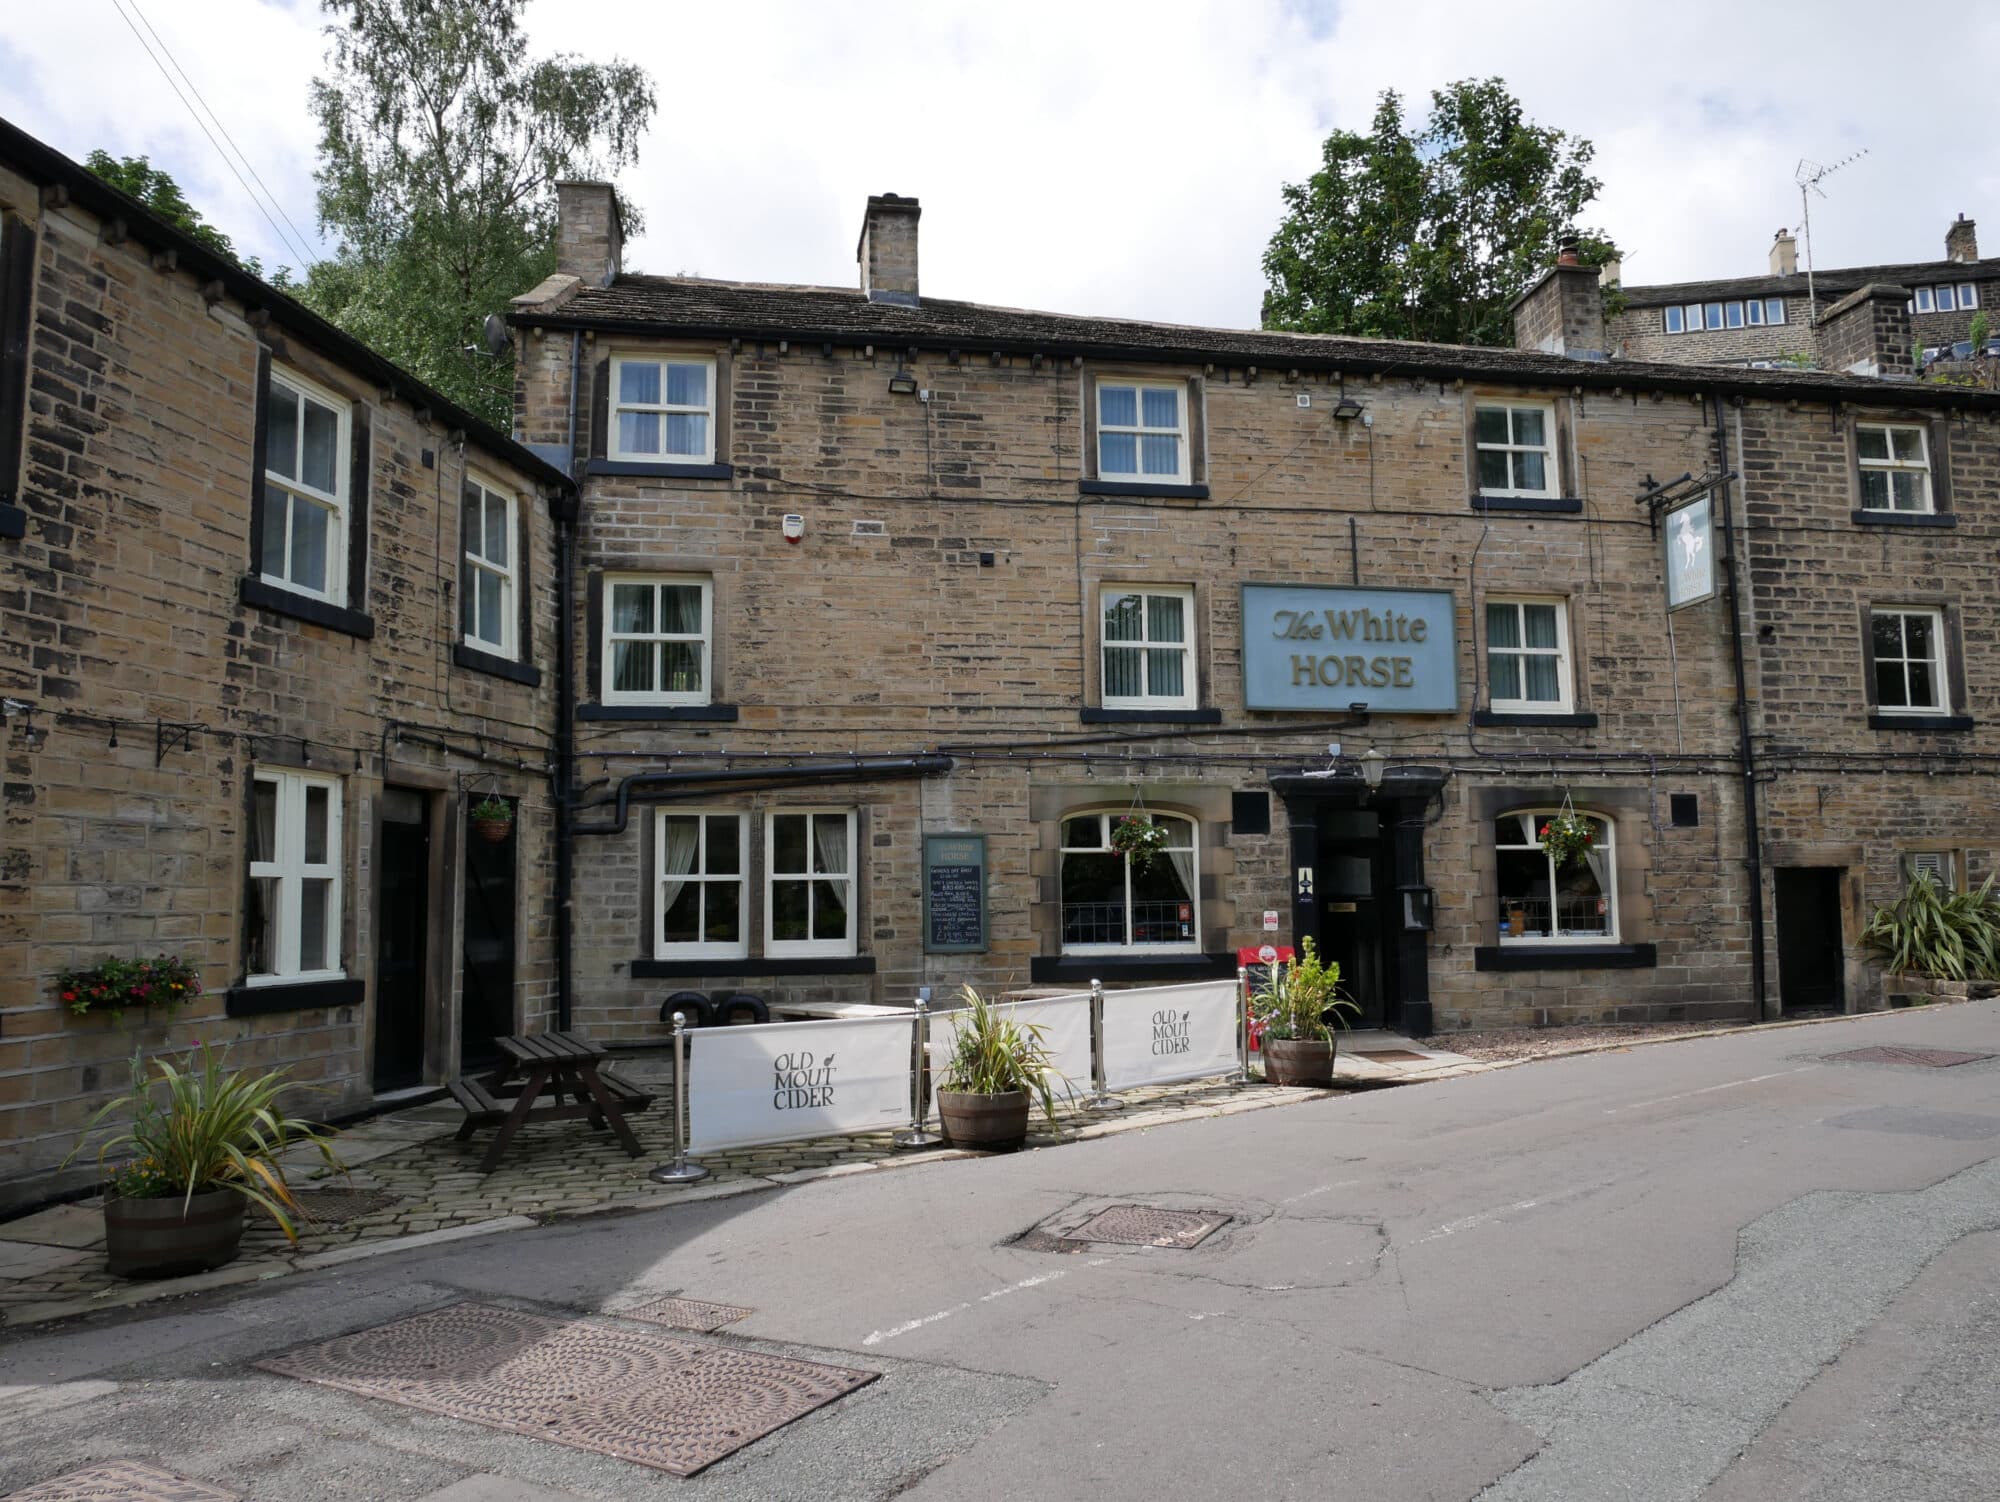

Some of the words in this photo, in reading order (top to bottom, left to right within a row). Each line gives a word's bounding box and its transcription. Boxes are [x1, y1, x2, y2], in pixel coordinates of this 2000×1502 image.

[1272, 610, 1323, 640] The
[1324, 607, 1428, 642] White
[1290, 655, 1415, 687] HORSE
[1152, 1009, 1177, 1025] OLD
[1152, 1021, 1192, 1041] MOUT
[1151, 1037, 1192, 1056] CIDER
[774, 1052, 814, 1072] OLD
[774, 1067, 837, 1090] MOUT
[773, 1086, 835, 1111] CIDER
